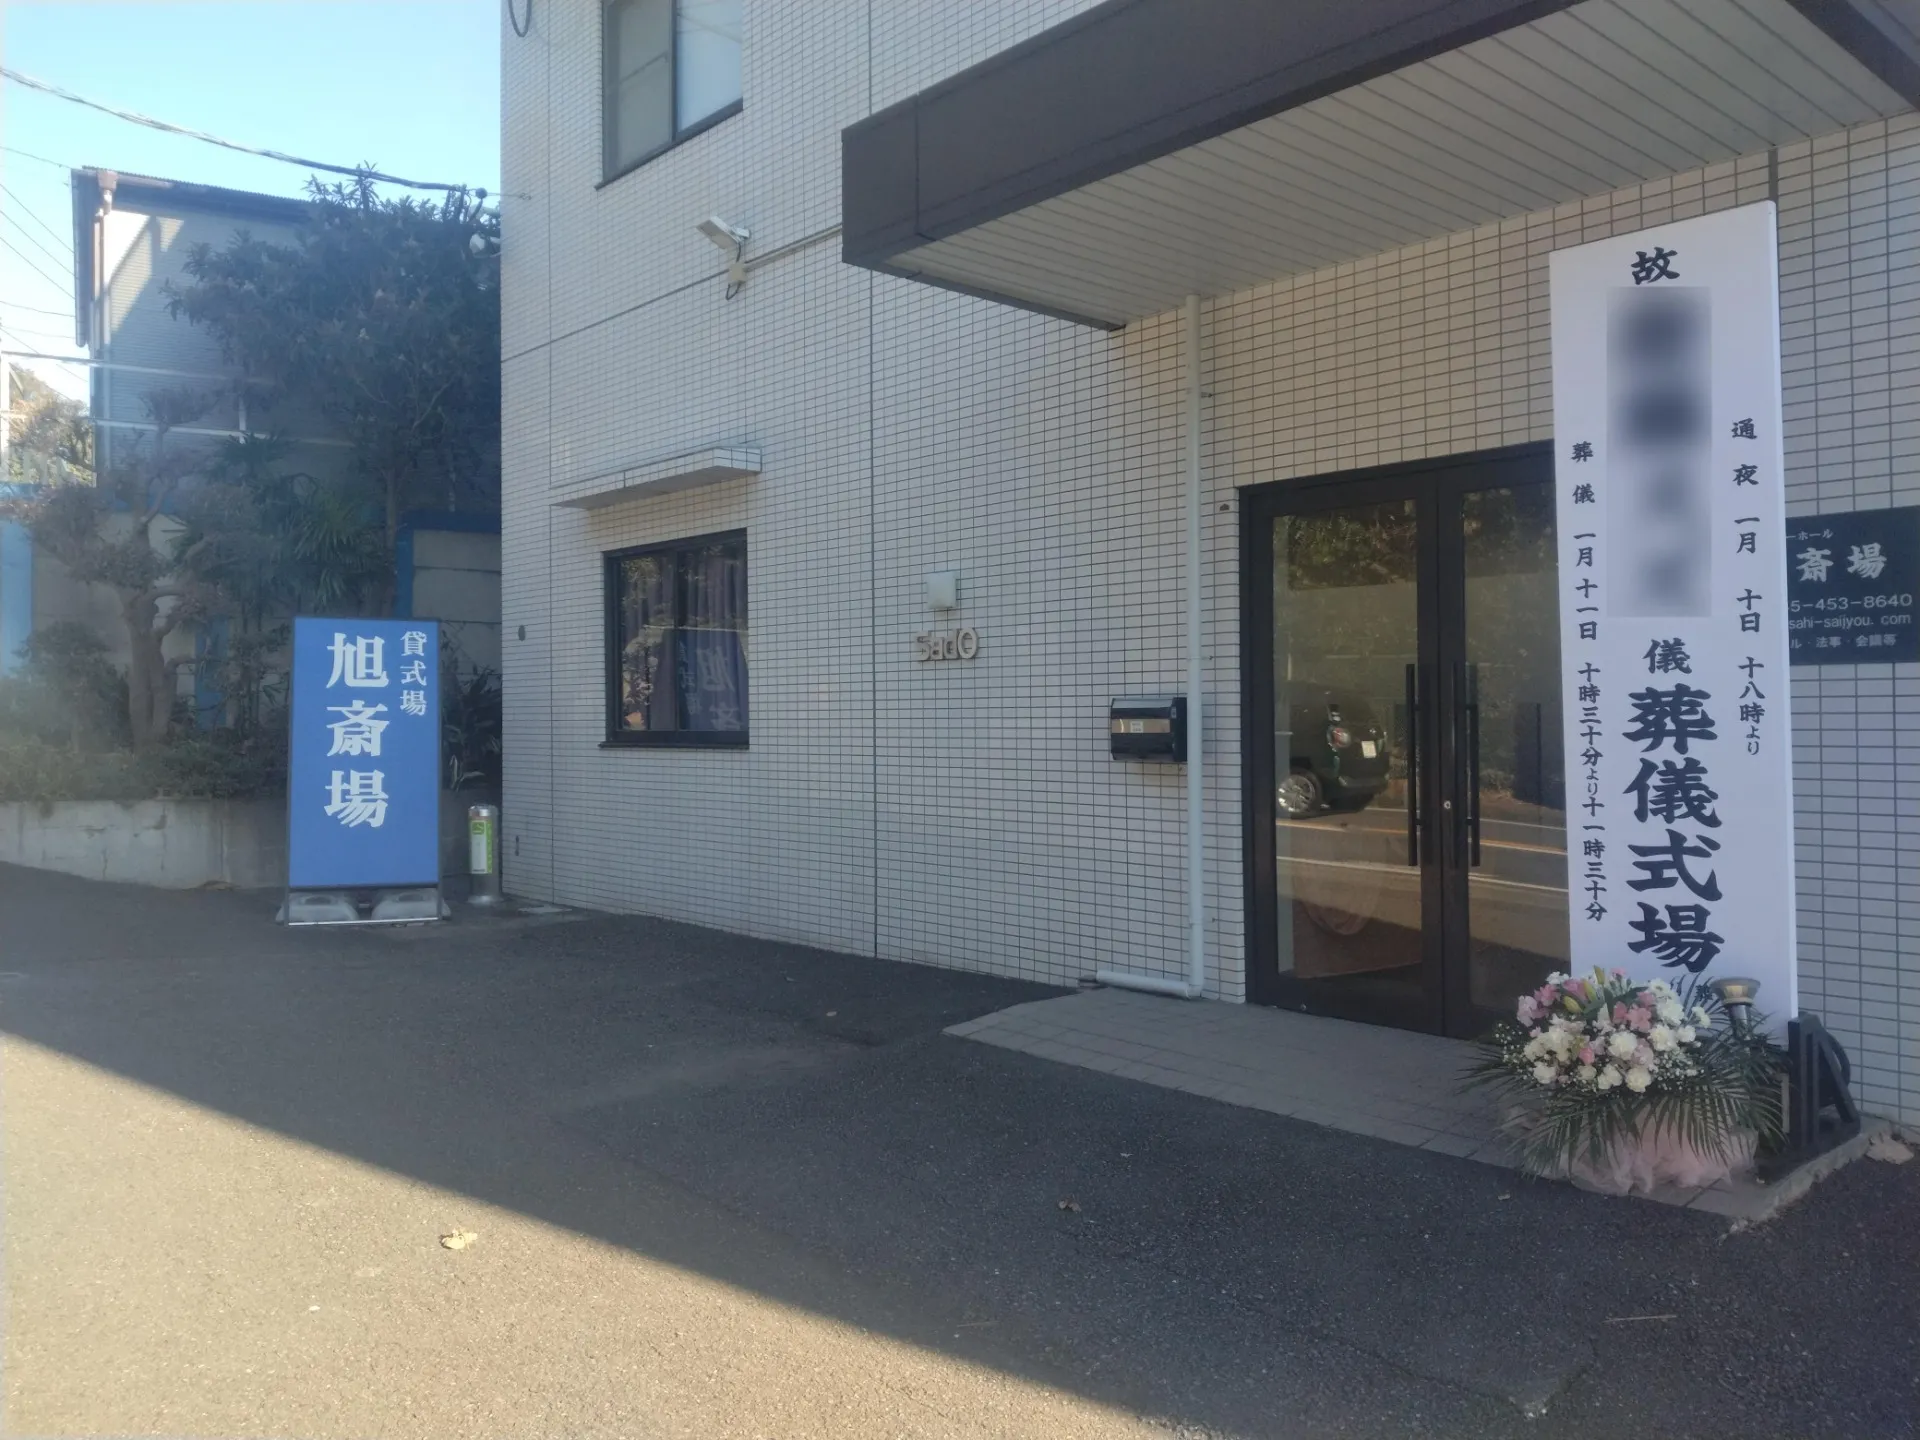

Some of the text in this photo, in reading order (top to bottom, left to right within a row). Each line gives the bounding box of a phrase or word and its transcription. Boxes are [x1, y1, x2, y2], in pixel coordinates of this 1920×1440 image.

[1630, 247, 1681, 286] 故
[1788, 593, 1913, 613] 5-453-8640
[1795, 542, 1888, 583] 斎場
[399, 631, 427, 717] 貸式場
[1642, 637, 1693, 675] 儀
[323, 632, 390, 829] 旭斎場
[1737, 656, 1767, 756] 十八時より
[1577, 661, 1608, 922] 十時三十分より十一時三十分
[1622, 682, 1726, 974] 葬儀式場
